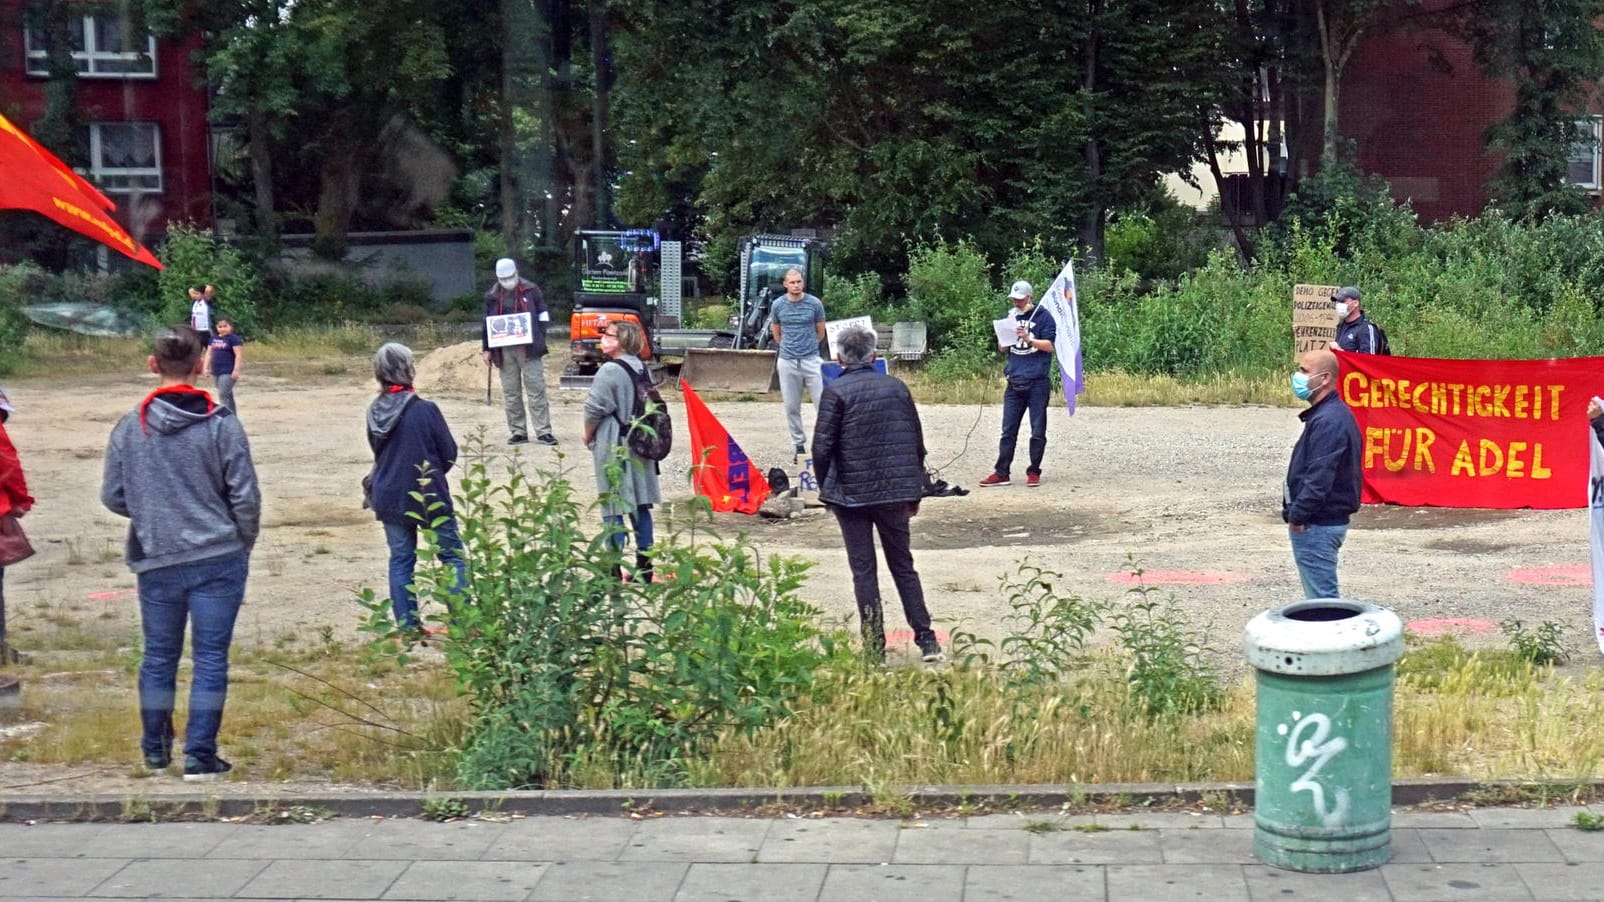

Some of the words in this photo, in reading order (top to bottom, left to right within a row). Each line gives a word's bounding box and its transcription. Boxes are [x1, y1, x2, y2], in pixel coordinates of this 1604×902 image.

[1343, 371, 1566, 421] GERECHTIGKEIT
[1364, 426, 1436, 474] FÜR
[1451, 438, 1552, 479] ADEL
